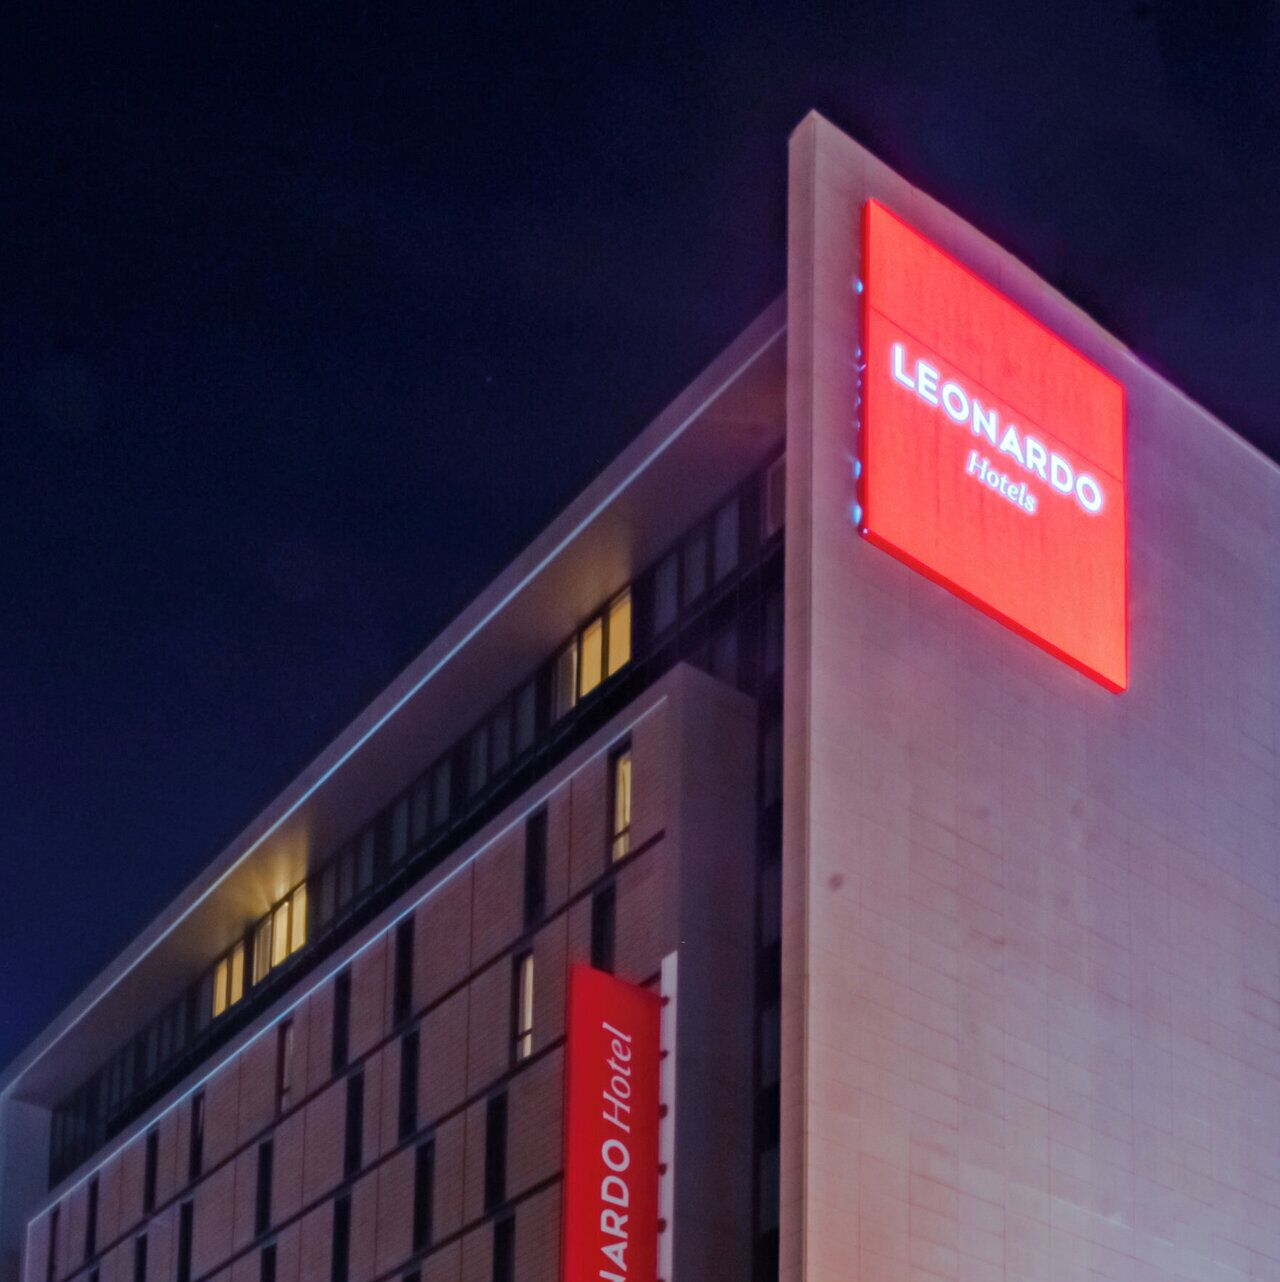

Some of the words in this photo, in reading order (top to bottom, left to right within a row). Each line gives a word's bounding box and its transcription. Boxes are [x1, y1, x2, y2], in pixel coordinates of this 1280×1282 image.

[892, 344, 1104, 514] LEONARDO
[966, 450, 1038, 516] Hotels
[602, 1021, 633, 1134] Hotel
